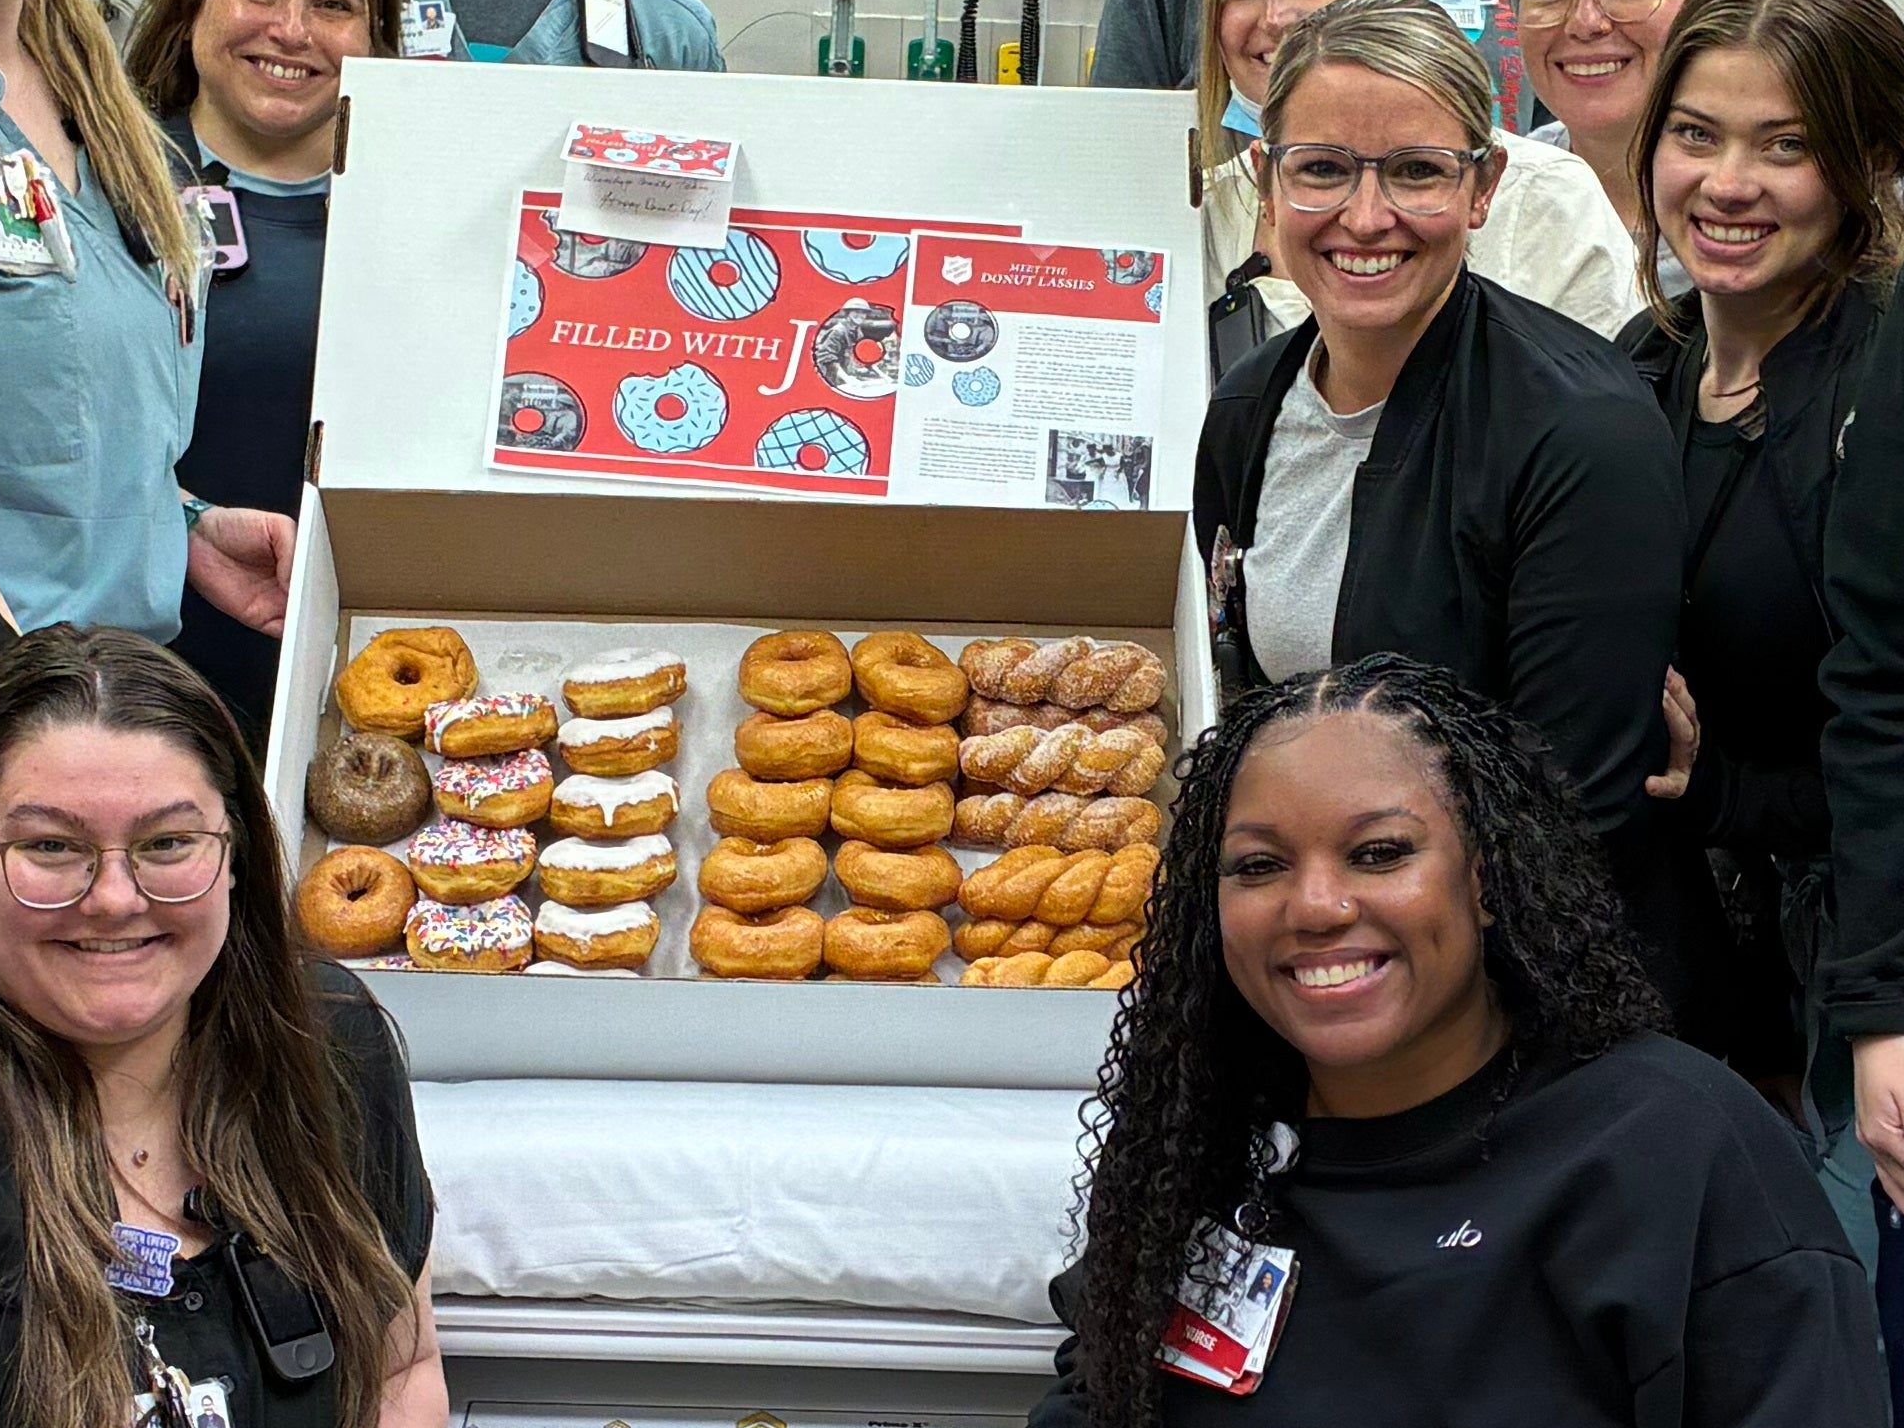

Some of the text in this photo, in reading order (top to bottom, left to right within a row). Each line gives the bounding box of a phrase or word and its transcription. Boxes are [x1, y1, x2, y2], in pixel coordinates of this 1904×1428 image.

[1009, 263, 1069, 276] MEET THE
[980, 272, 1096, 291] DONUT LASSIES
[549, 320, 672, 352] FILLED
[682, 331, 783, 362] WITH
